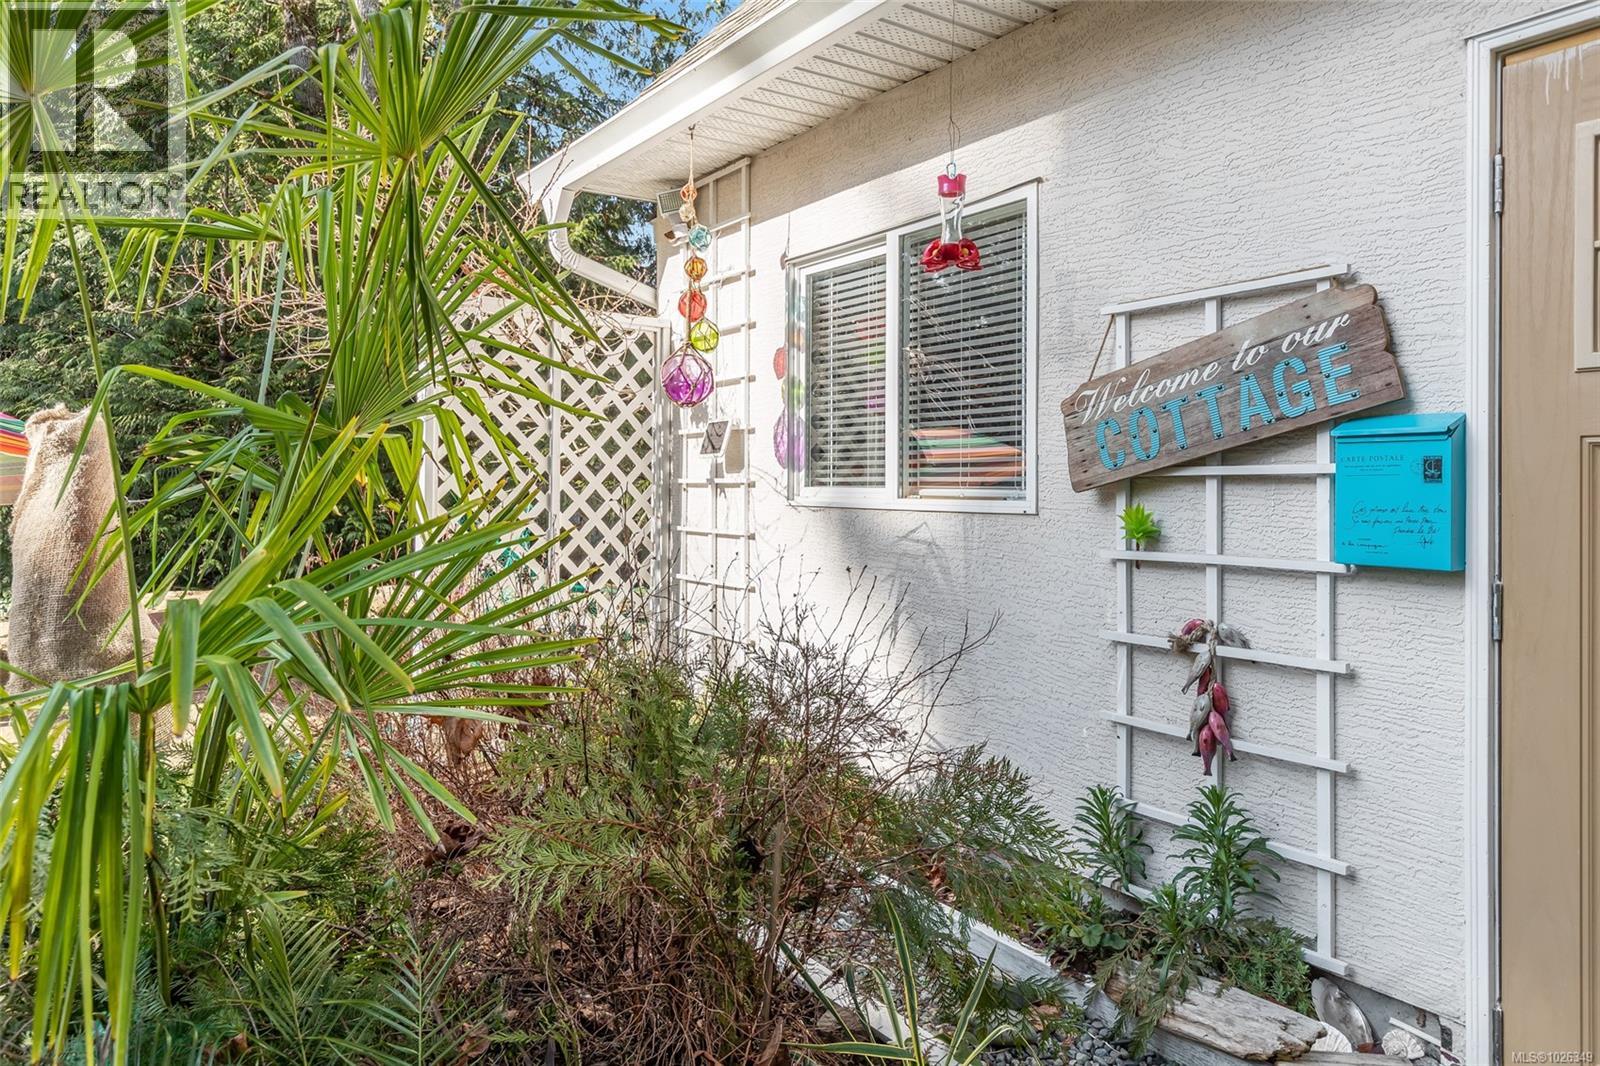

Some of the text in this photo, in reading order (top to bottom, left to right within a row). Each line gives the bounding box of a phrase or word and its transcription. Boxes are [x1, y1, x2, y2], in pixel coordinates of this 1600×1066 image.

[1075, 313, 1351, 426] Welcome to our
[1095, 343, 1361, 471] COTTAGE
[1369, 454, 1404, 462] POSTALE
